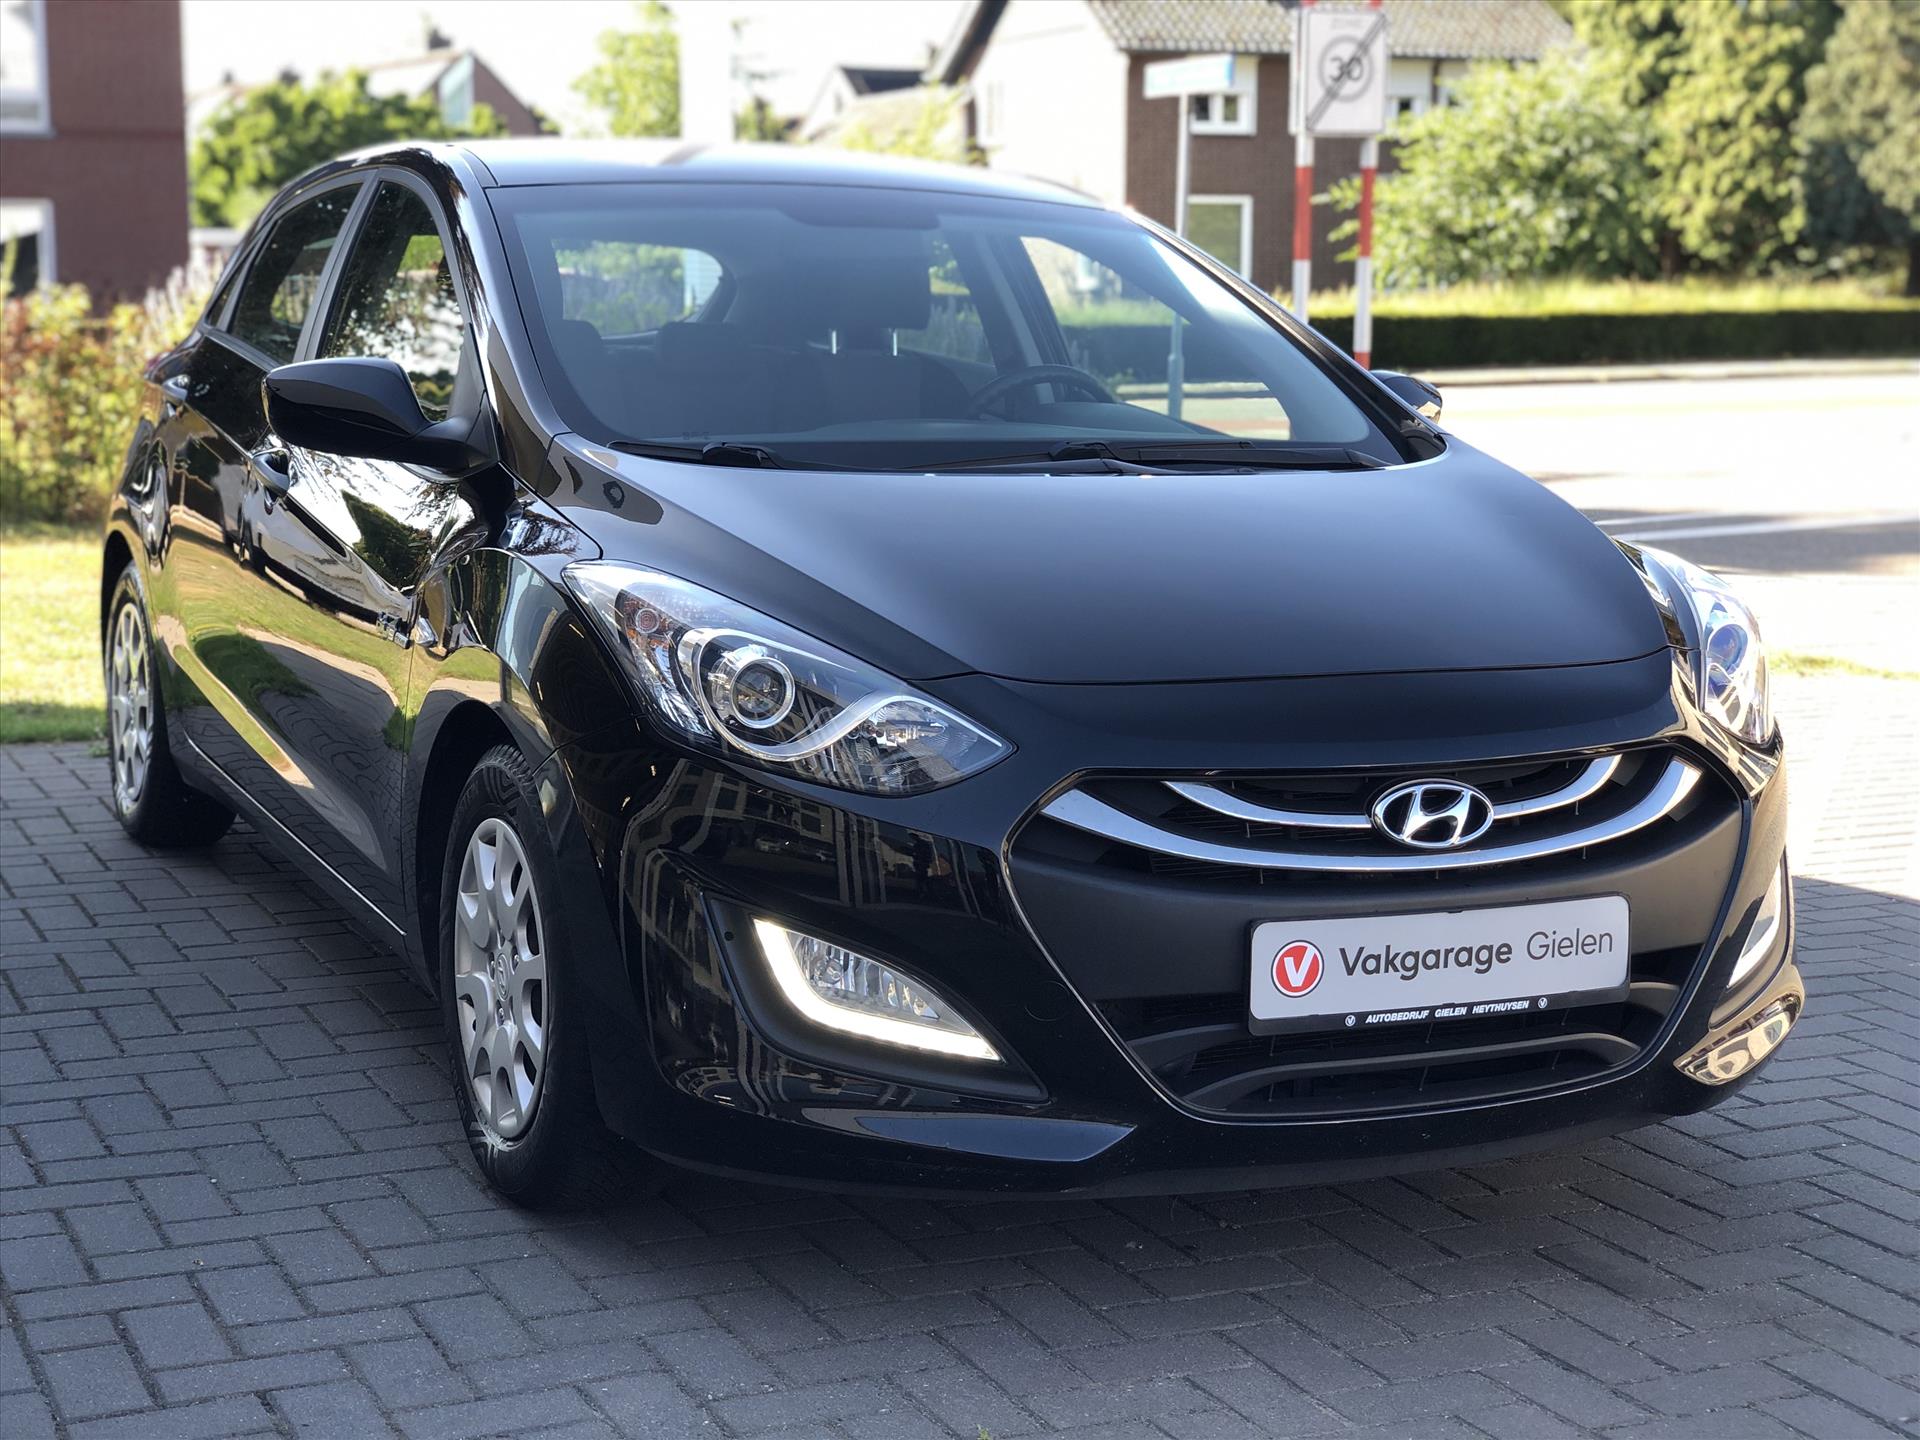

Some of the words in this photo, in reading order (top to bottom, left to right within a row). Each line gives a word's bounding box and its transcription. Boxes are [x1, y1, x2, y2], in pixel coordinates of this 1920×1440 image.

[1329, 56, 1364, 82] 30
[1339, 942, 1513, 981] Vakgarage
[1526, 928, 1613, 960] Gielen
[1365, 1010, 1429, 1024] AUTOBEDRIJF
[1434, 1007, 1467, 1018] GIELEN
[1472, 1000, 1530, 1014] HEYTHUYSEN
